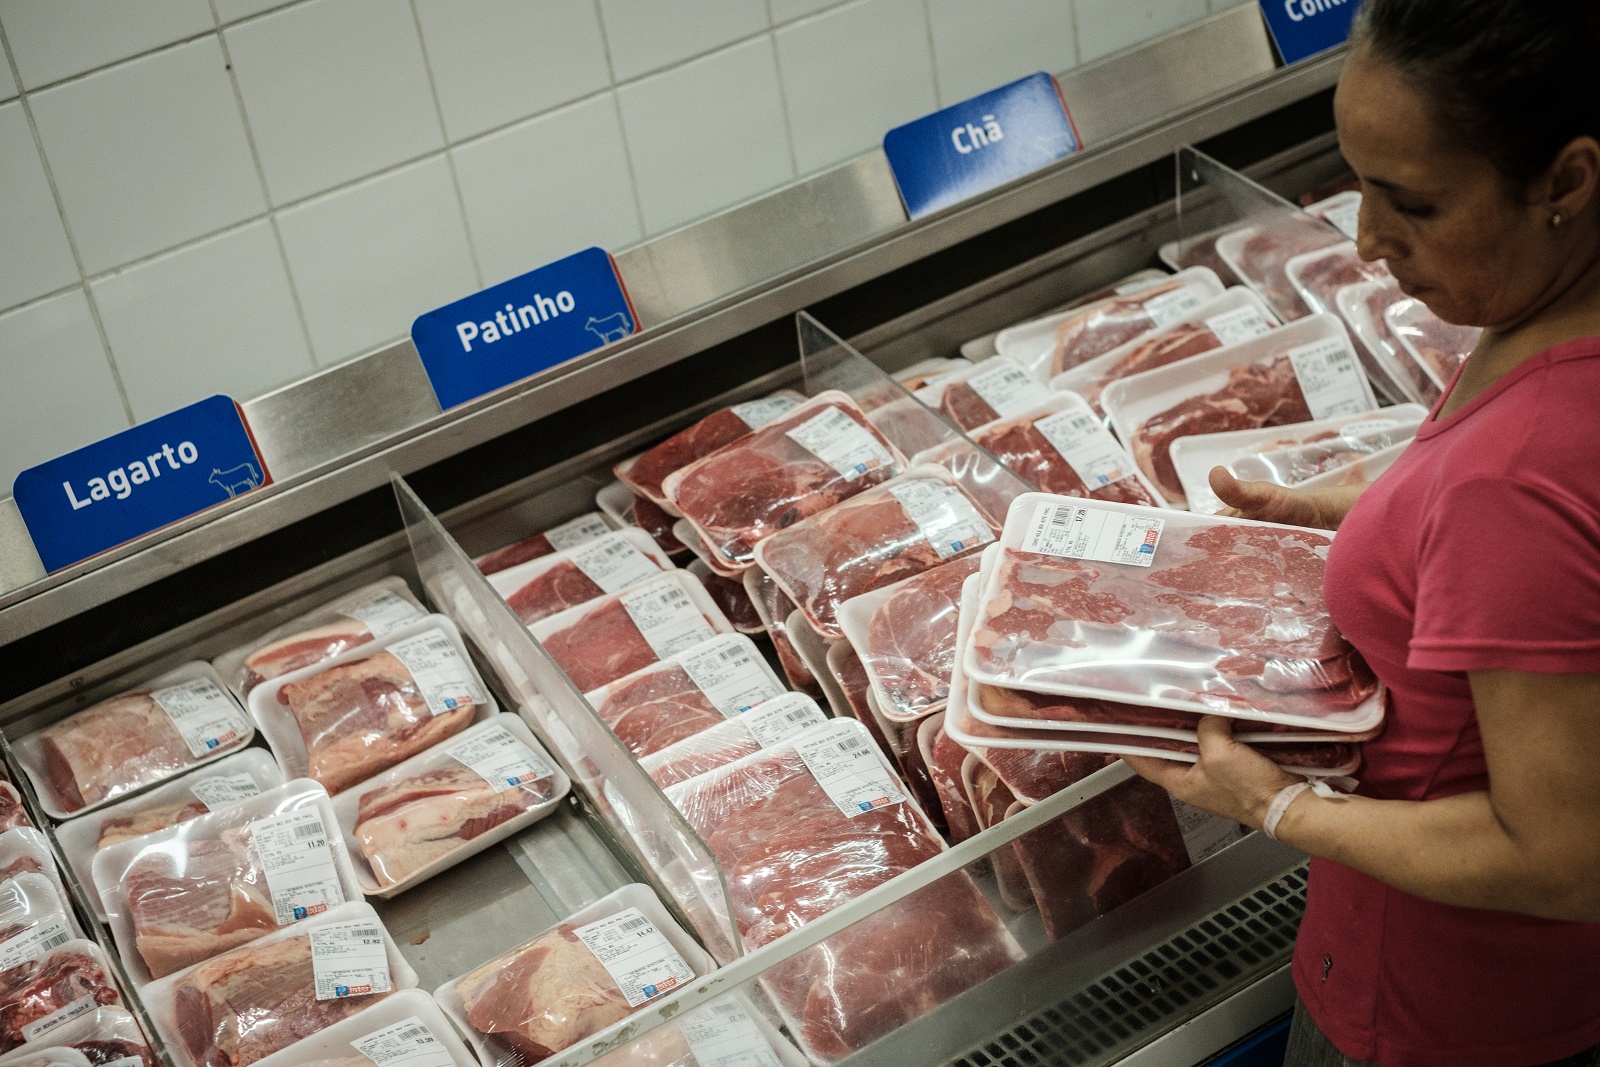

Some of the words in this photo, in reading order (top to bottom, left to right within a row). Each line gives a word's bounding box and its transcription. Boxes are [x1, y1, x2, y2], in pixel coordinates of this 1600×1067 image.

[1285, 0, 1347, 21] Con
[951, 114, 1004, 154] Chã
[456, 291, 575, 352] Patinho
[62, 440, 199, 511] Lagarto
[307, 839, 325, 849] 11.20
[637, 927, 654, 938] 14.47
